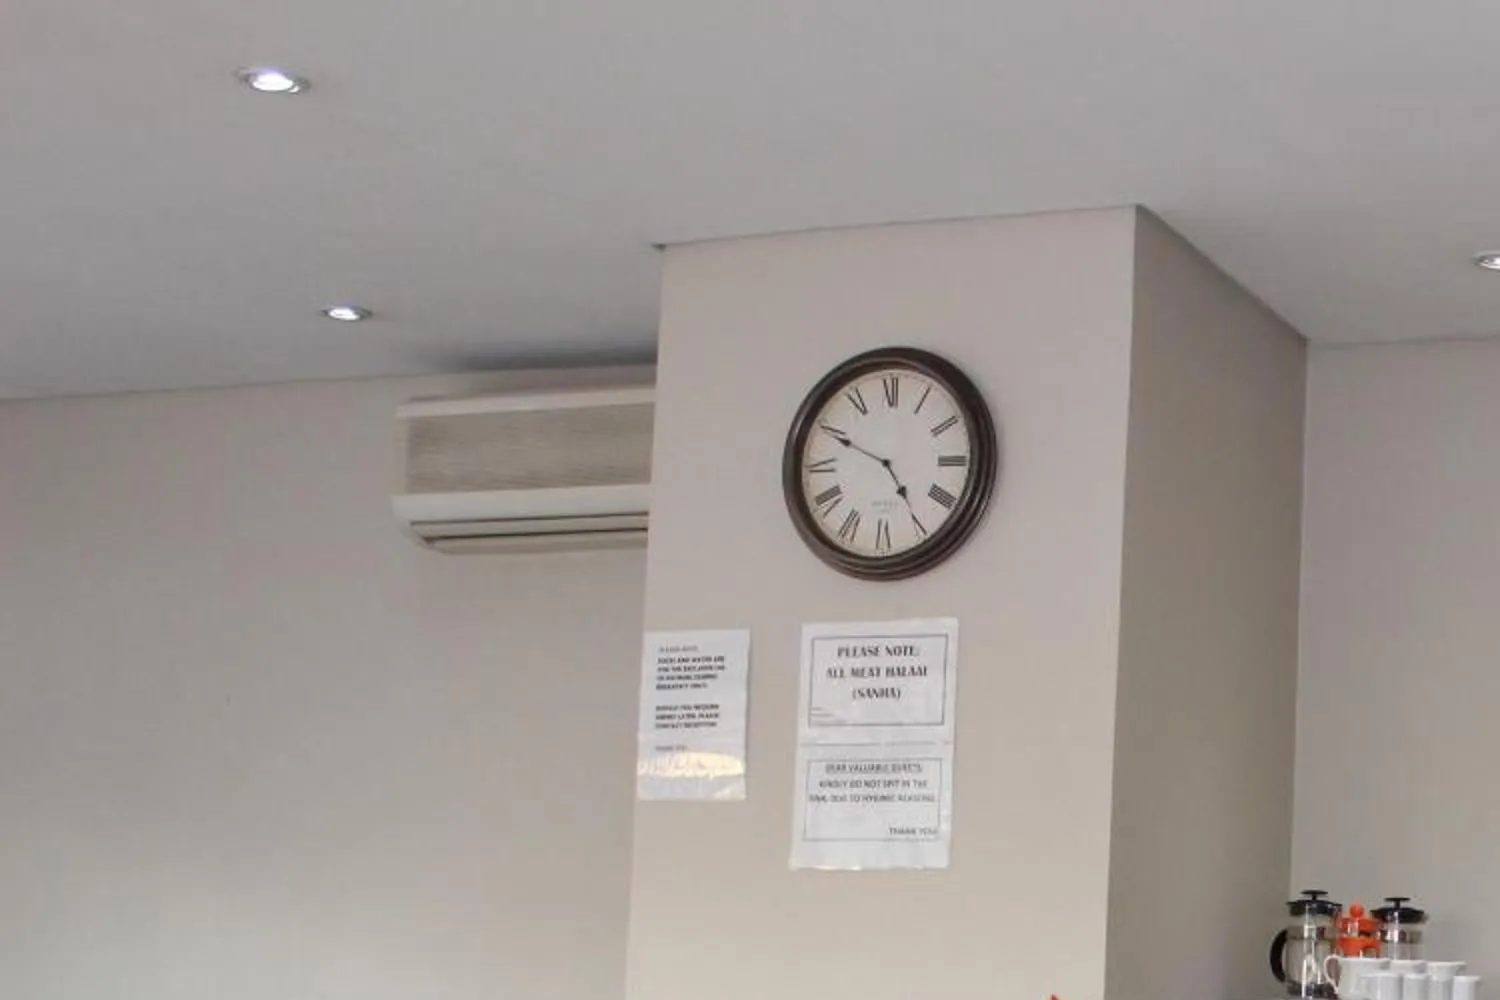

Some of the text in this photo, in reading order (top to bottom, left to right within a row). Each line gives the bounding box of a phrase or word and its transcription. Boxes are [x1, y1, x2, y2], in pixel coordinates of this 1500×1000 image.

[837, 645, 881, 658] PLEASE
[850, 666, 882, 678] MEAT
[863, 779, 881, 789] NOT
